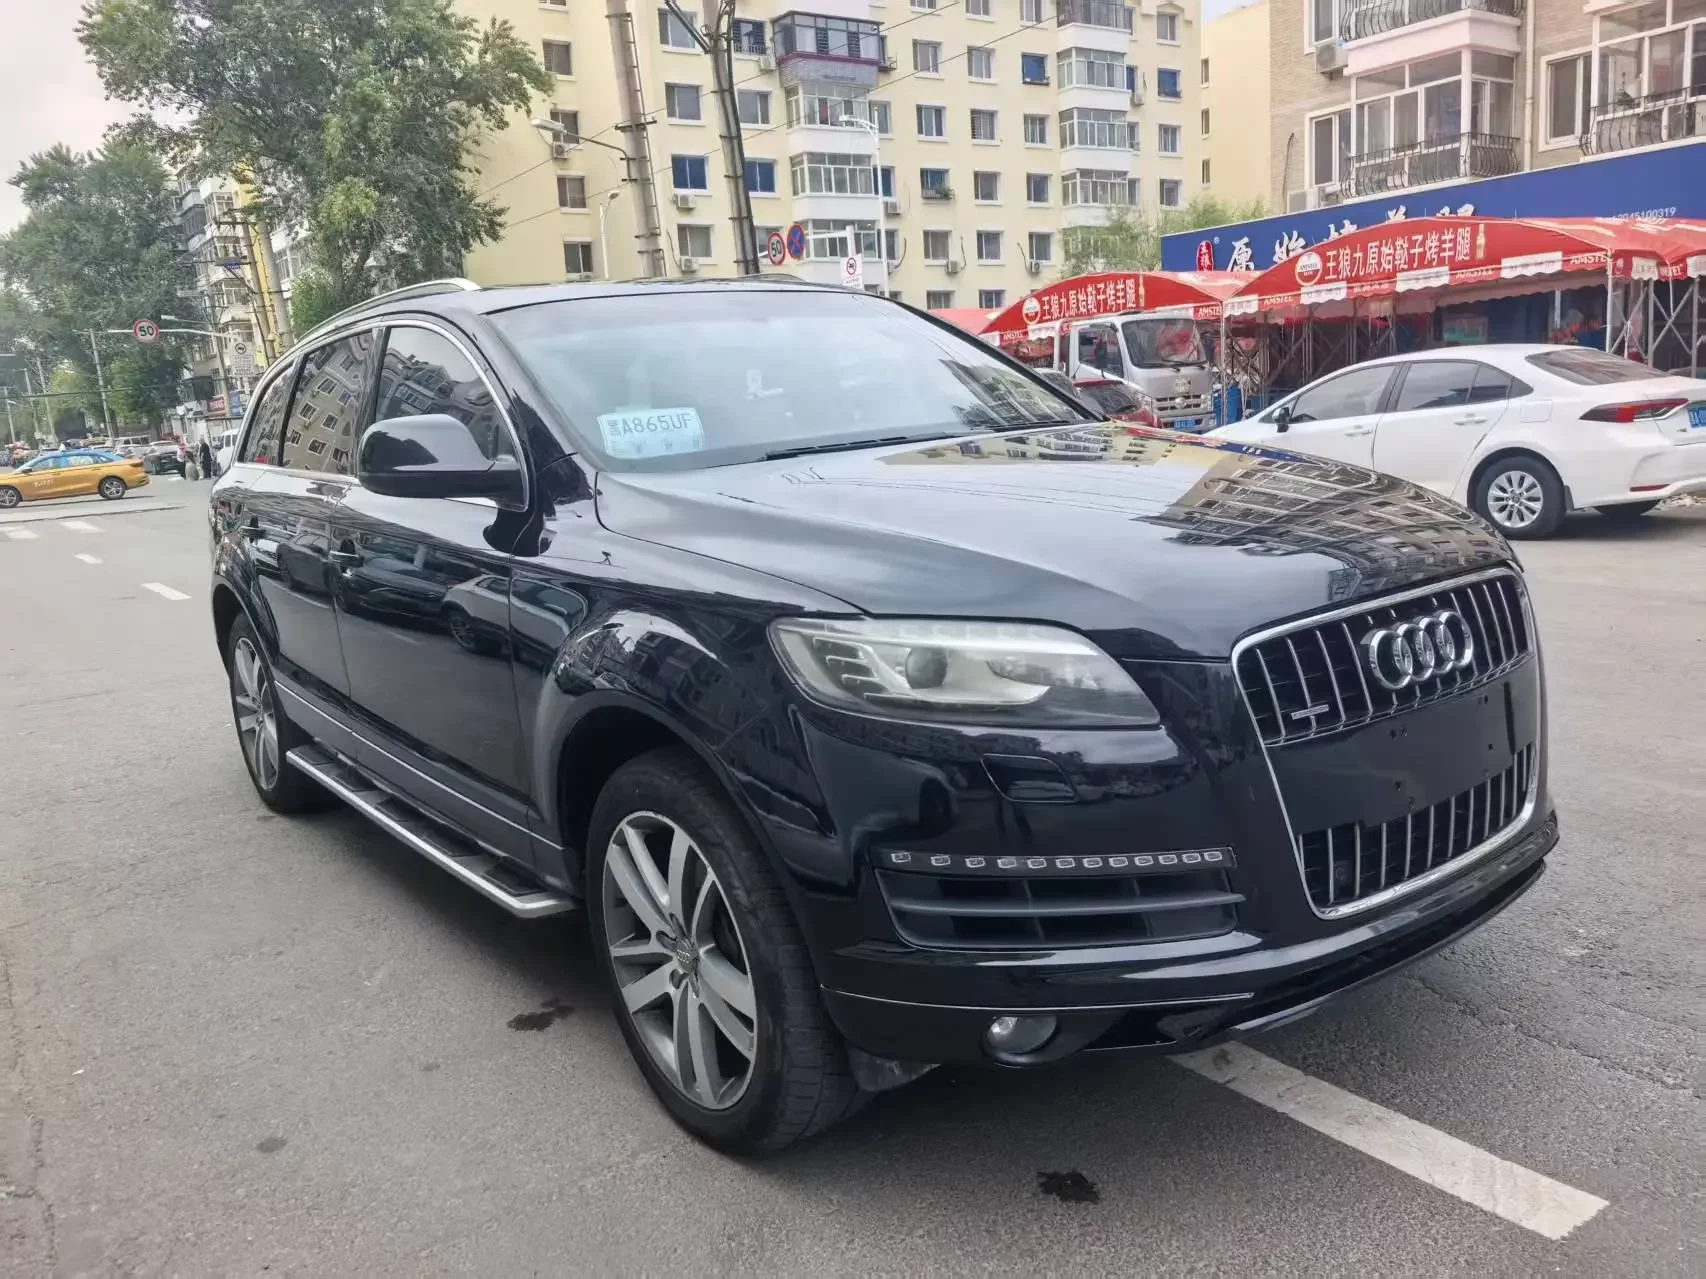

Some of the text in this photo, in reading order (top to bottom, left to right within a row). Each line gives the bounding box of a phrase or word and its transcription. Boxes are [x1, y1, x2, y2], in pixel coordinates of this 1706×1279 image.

[770, 240, 782, 258] 50
[1198, 305, 1222, 317] AMSTE
[139, 325, 155, 337] 50
